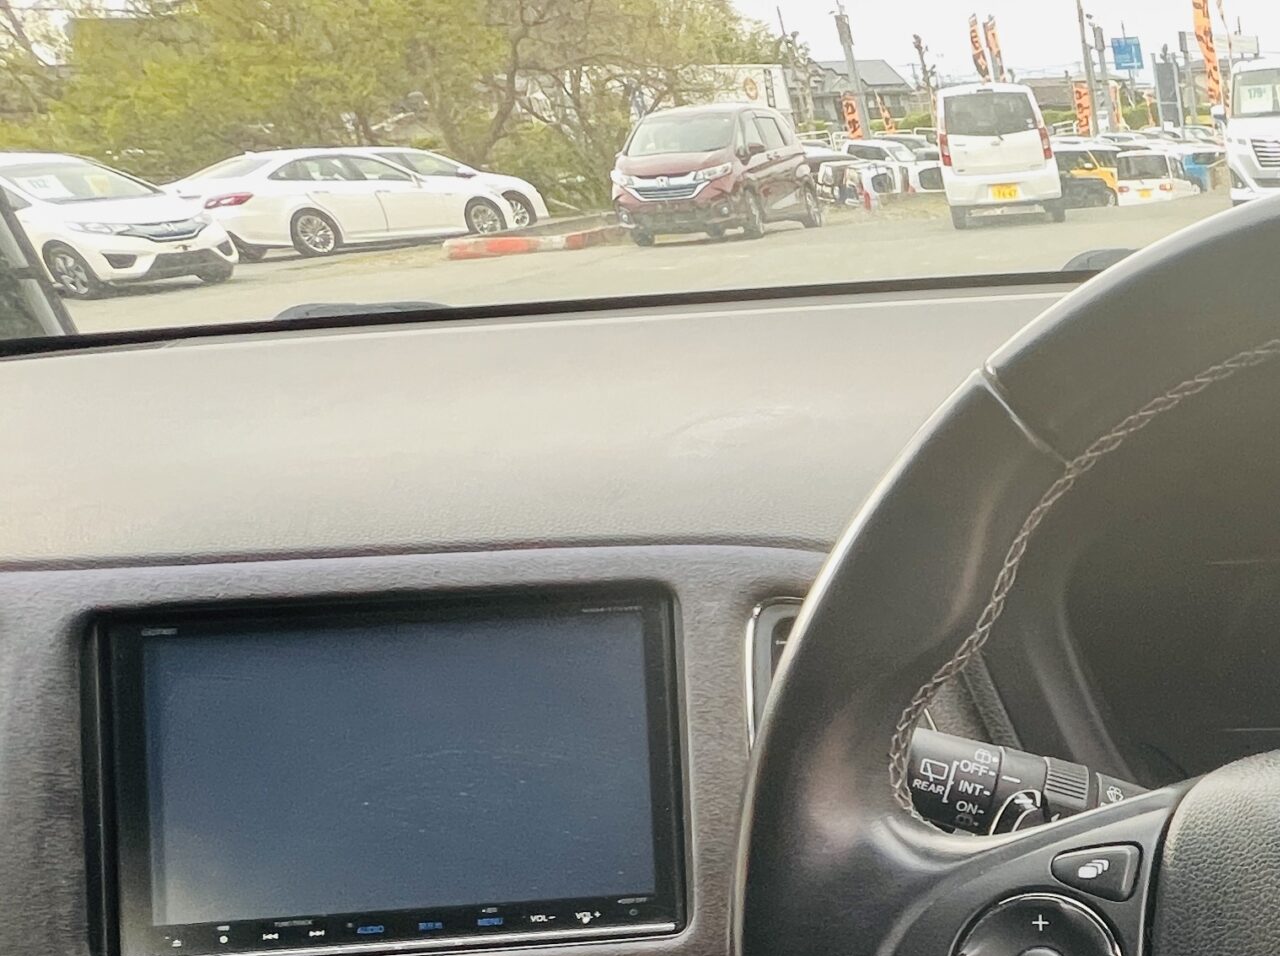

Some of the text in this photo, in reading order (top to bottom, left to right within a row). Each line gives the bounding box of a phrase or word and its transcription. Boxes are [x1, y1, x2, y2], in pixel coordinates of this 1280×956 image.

[959, 760, 989, 776] OFF
[912, 778, 945, 796] REAR
[959, 779, 984, 796] INT
[956, 800, 977, 815] ON
